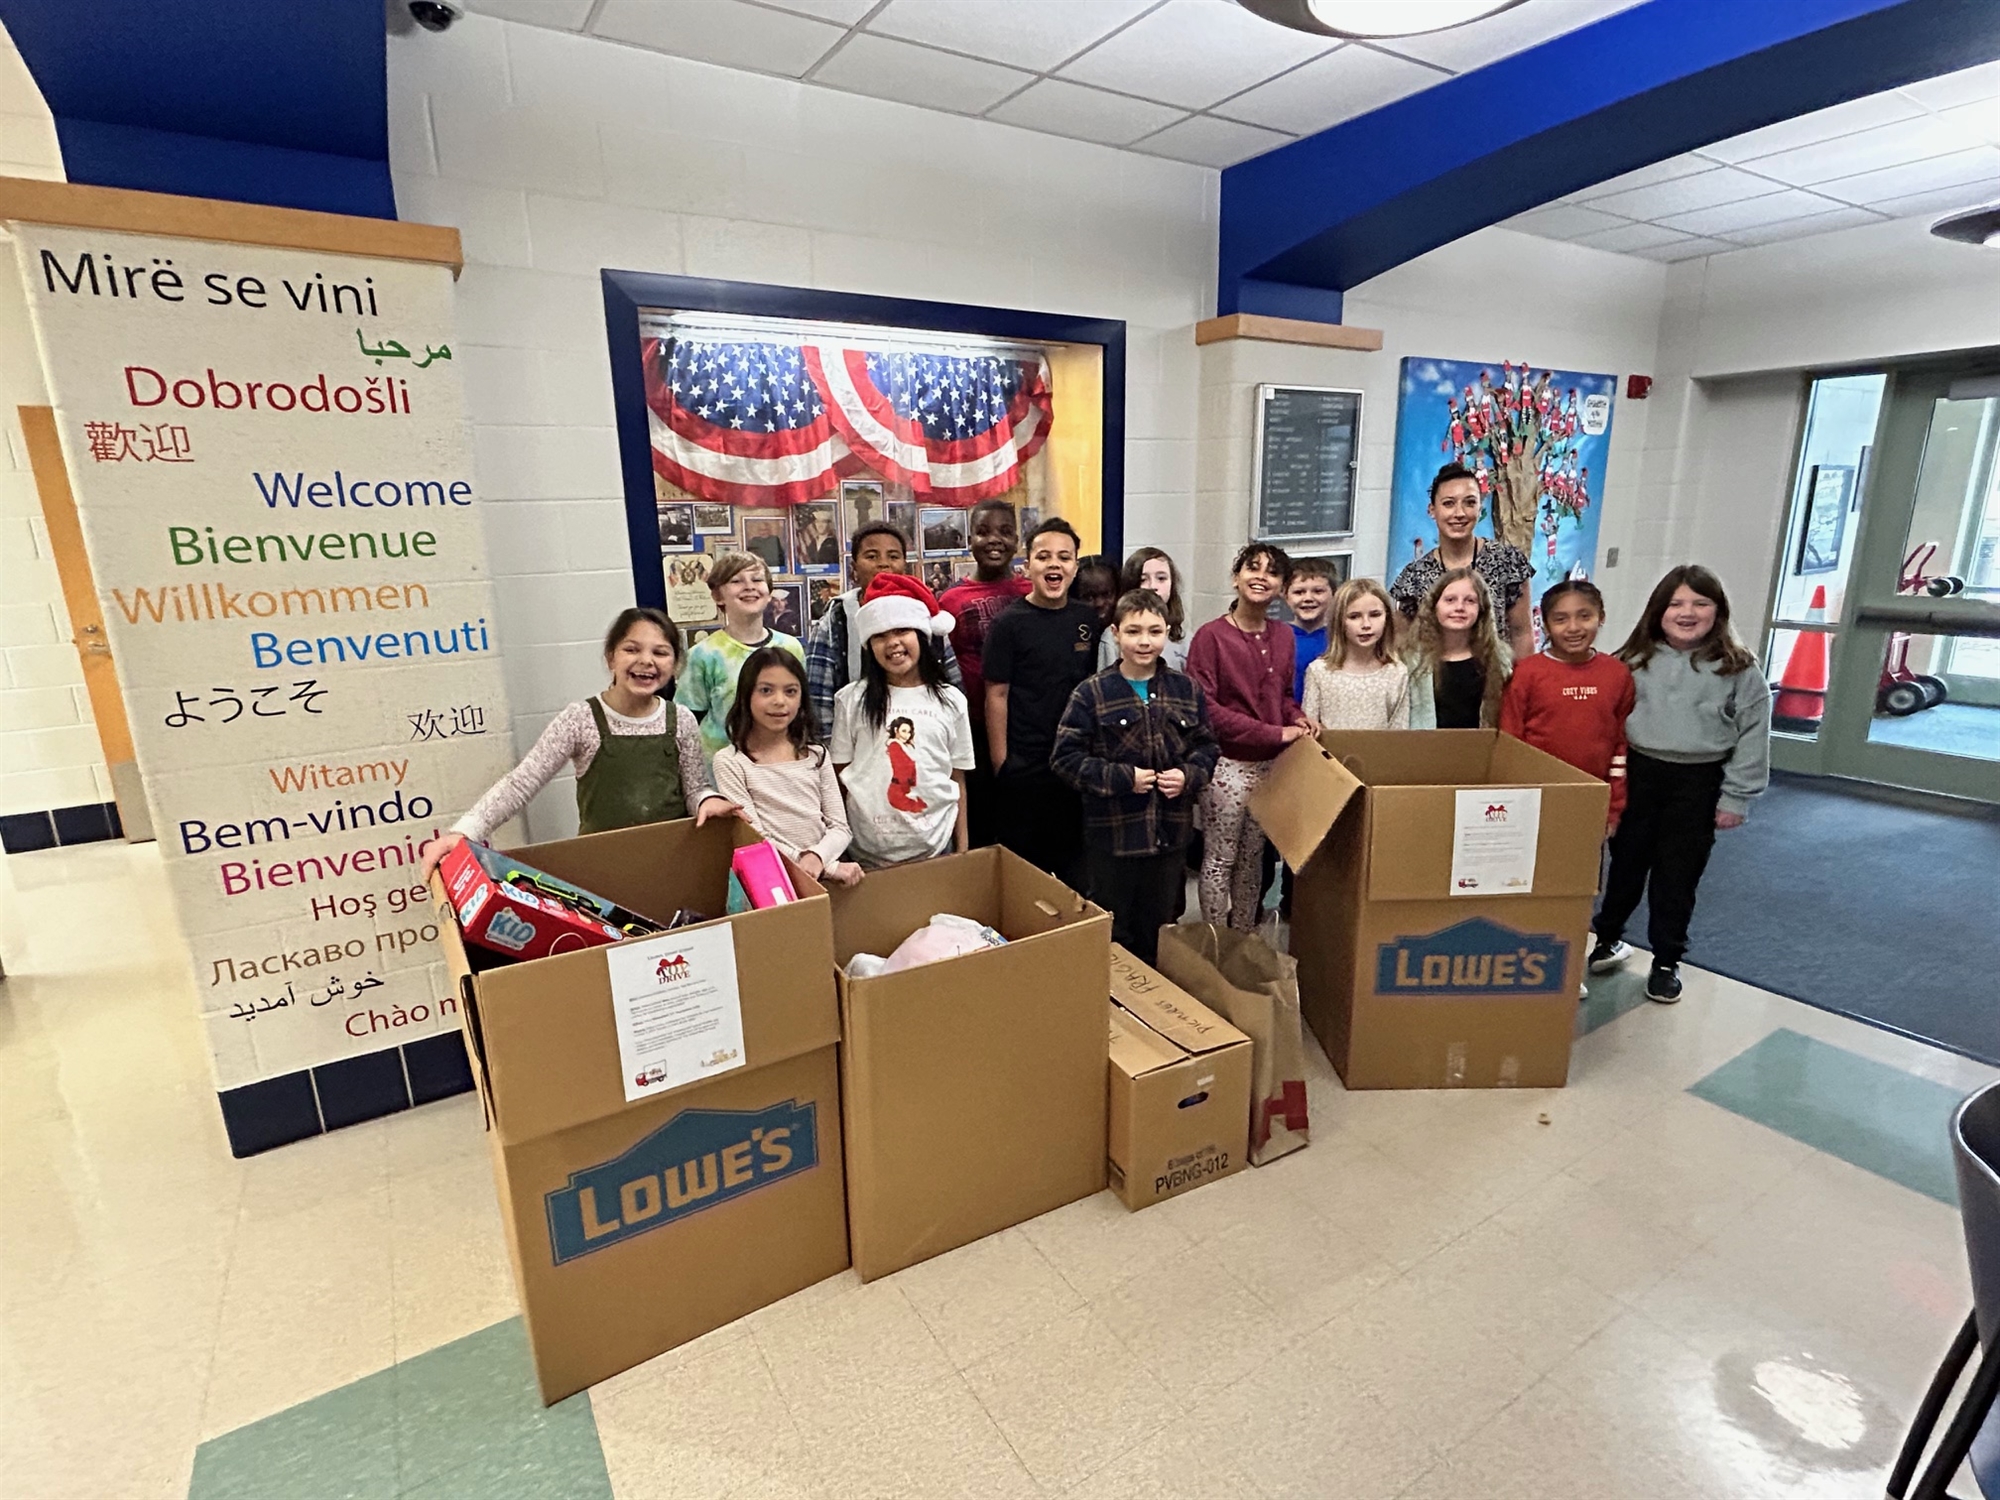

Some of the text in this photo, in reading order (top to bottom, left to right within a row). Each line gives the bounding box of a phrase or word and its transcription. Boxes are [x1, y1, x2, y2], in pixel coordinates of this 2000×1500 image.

[40, 248, 379, 317] Mirë se vini
[356, 328, 452, 368] مرحبا
[124, 366, 412, 415] Dobrodošli
[83, 421, 196, 463] 歡迎
[252, 470, 473, 509] Welcome
[168, 526, 437, 566] Bienvenue
[112, 582, 429, 625] Willkommen
[250, 619, 489, 669] Benvenuti
[164, 679, 329, 728] ようこそ
[407, 704, 488, 743] 欢迎
[268, 758, 409, 795] Witamy
[179, 789, 434, 855] Bem-vindo
[220, 828, 440, 896] Bienveni
[311, 893, 377, 922] Hoş
[490, 914, 535, 941] KID
[211, 939, 365, 988] Ласкаво
[659, 971, 691, 985] DRIVE
[1394, 947, 1549, 987] LOWE'S
[310, 970, 385, 1007] خوش
[345, 1003, 430, 1037] Chào
[578, 1126, 794, 1241] LOWE'S
